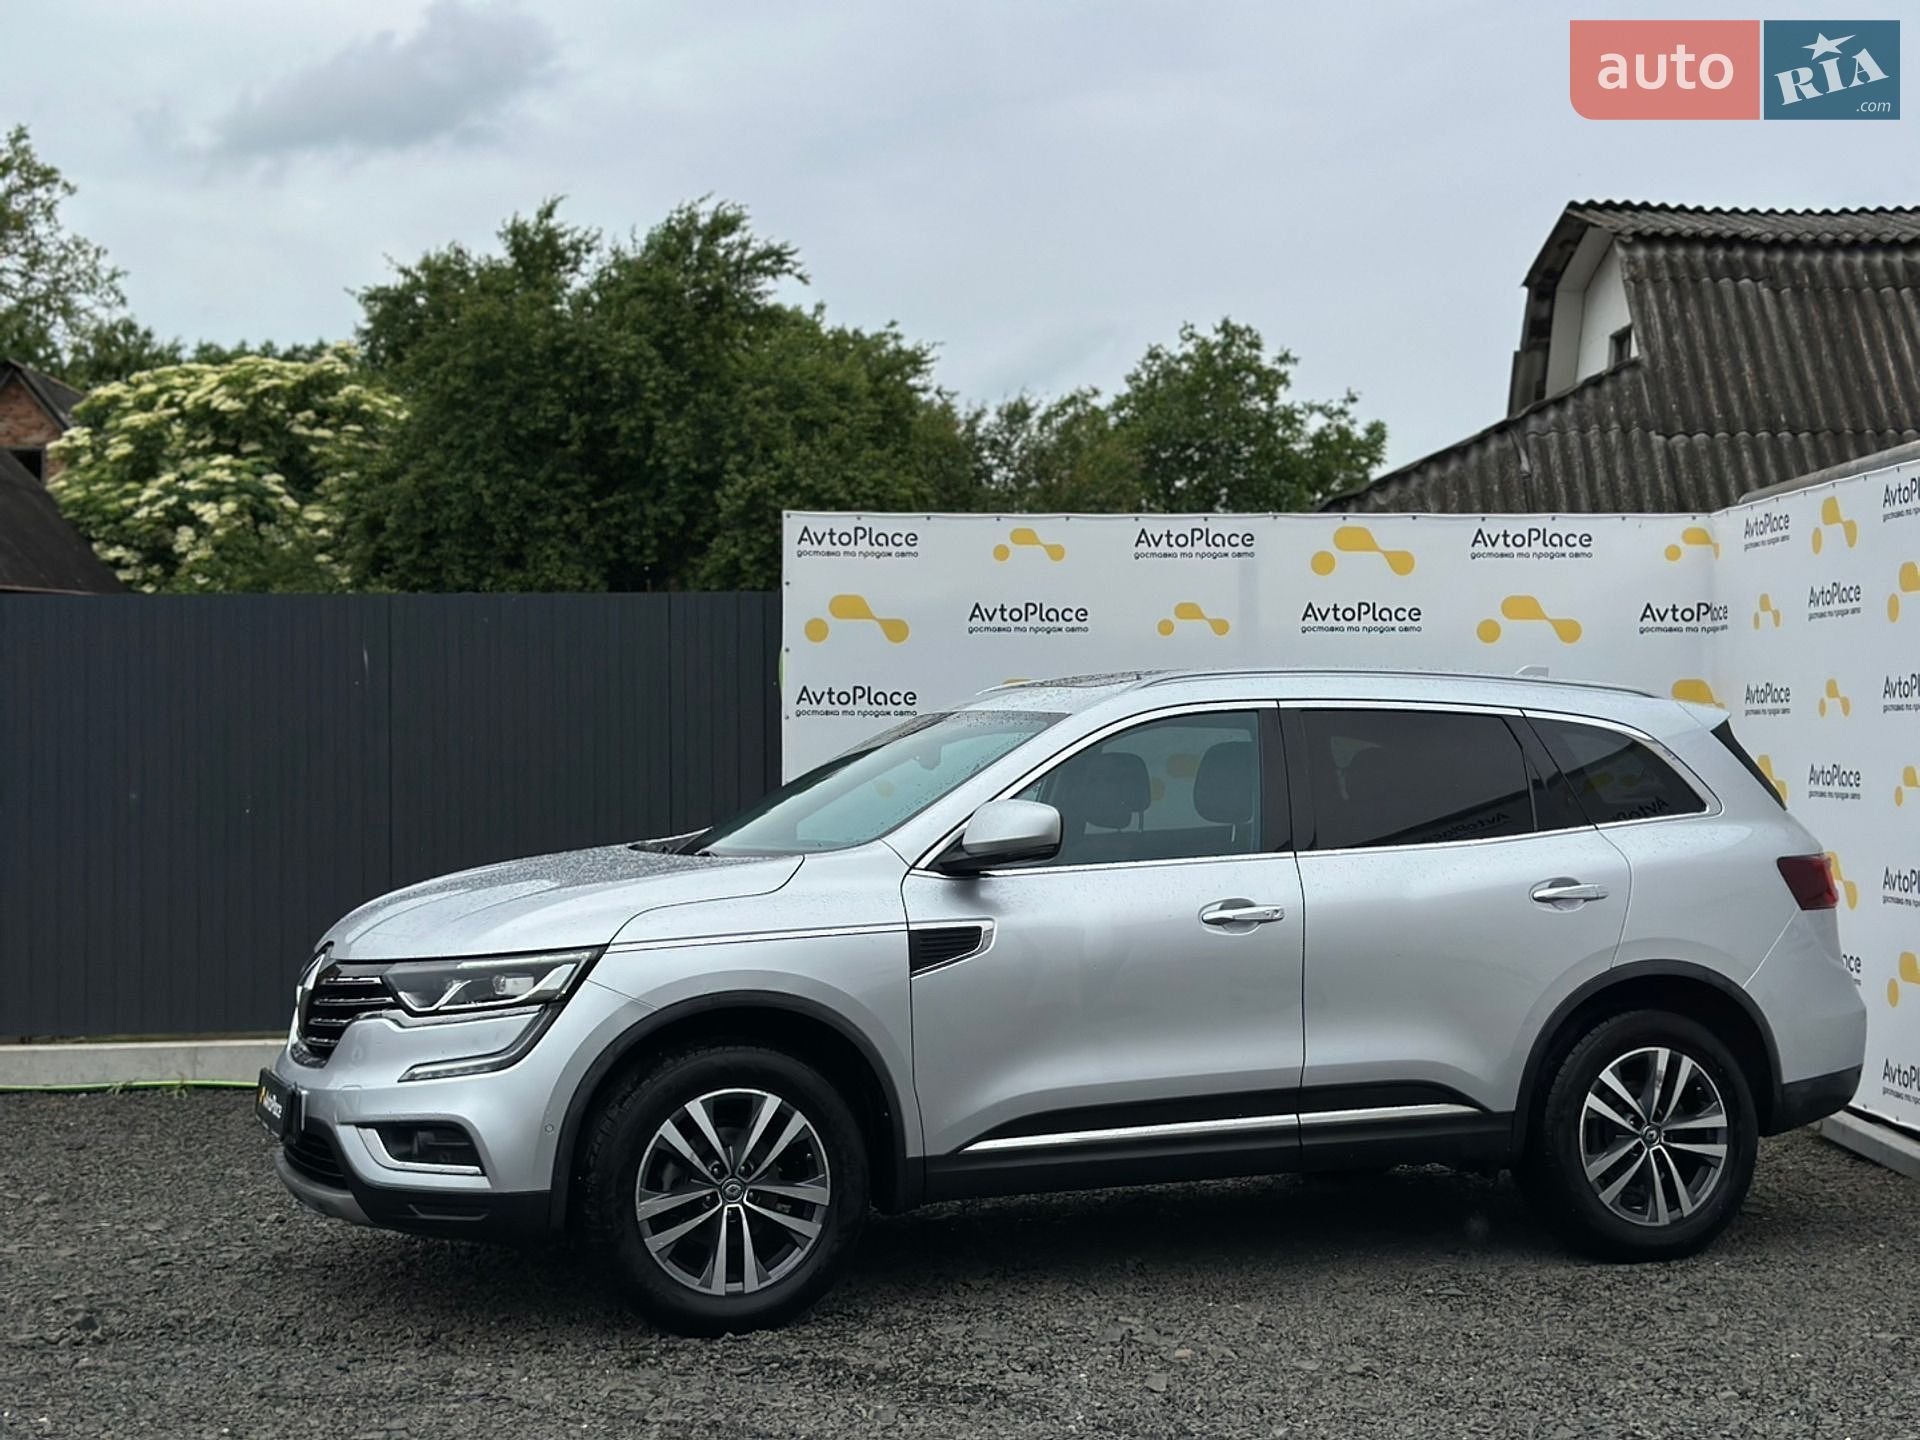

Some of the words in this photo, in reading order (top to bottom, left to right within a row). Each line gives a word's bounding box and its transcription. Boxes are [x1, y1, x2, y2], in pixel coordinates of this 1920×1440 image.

[1743, 511, 1790, 539] AvtoPlace
[797, 525, 919, 548] AvtoPlace
[1134, 527, 1256, 549] AvtoPlace
[1470, 527, 1594, 549] AvtoPlace
[1807, 581, 1861, 608] AvtoPlace
[968, 601, 1090, 623] AvtoPlace
[1300, 601, 1423, 623] AvtoPlace
[1639, 602, 1729, 623] AvtoPlace
[796, 685, 918, 707] AvtoPlace
[1744, 682, 1791, 704] AvtoPlace
[1808, 763, 1861, 788] AvtoPlace
